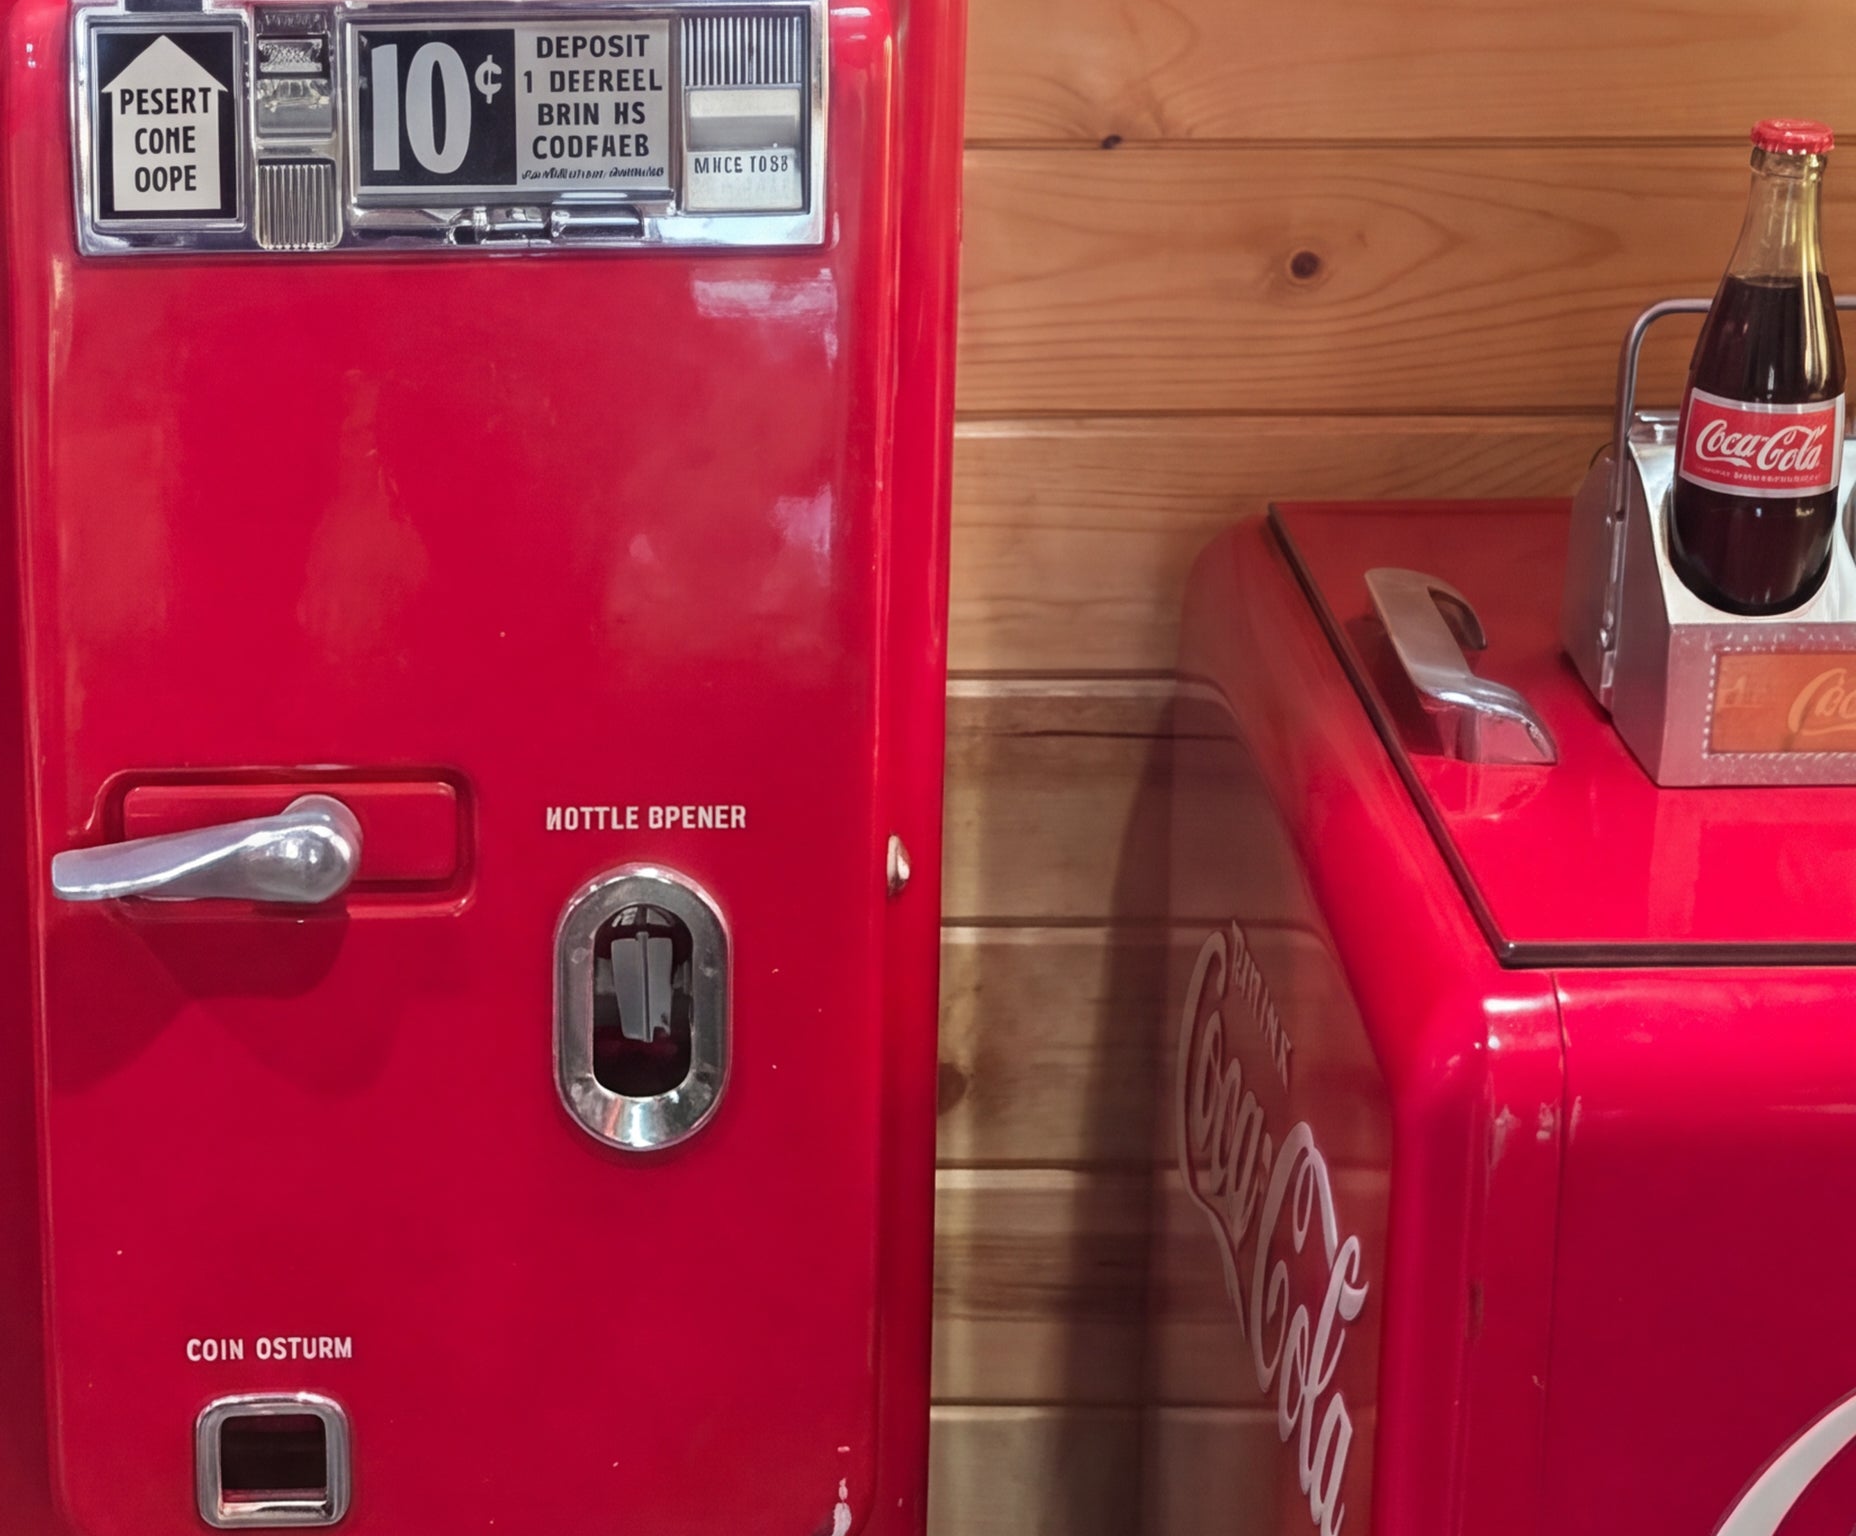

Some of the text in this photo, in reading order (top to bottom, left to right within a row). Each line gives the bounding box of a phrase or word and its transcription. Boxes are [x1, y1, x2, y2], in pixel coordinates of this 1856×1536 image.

[536, 34, 650, 59] DEPOSIT
[120, 87, 211, 115] PESERT
[1695, 418, 1828, 472] Coca-Cola
[186, 1336, 353, 1361] COIN OSTURM
